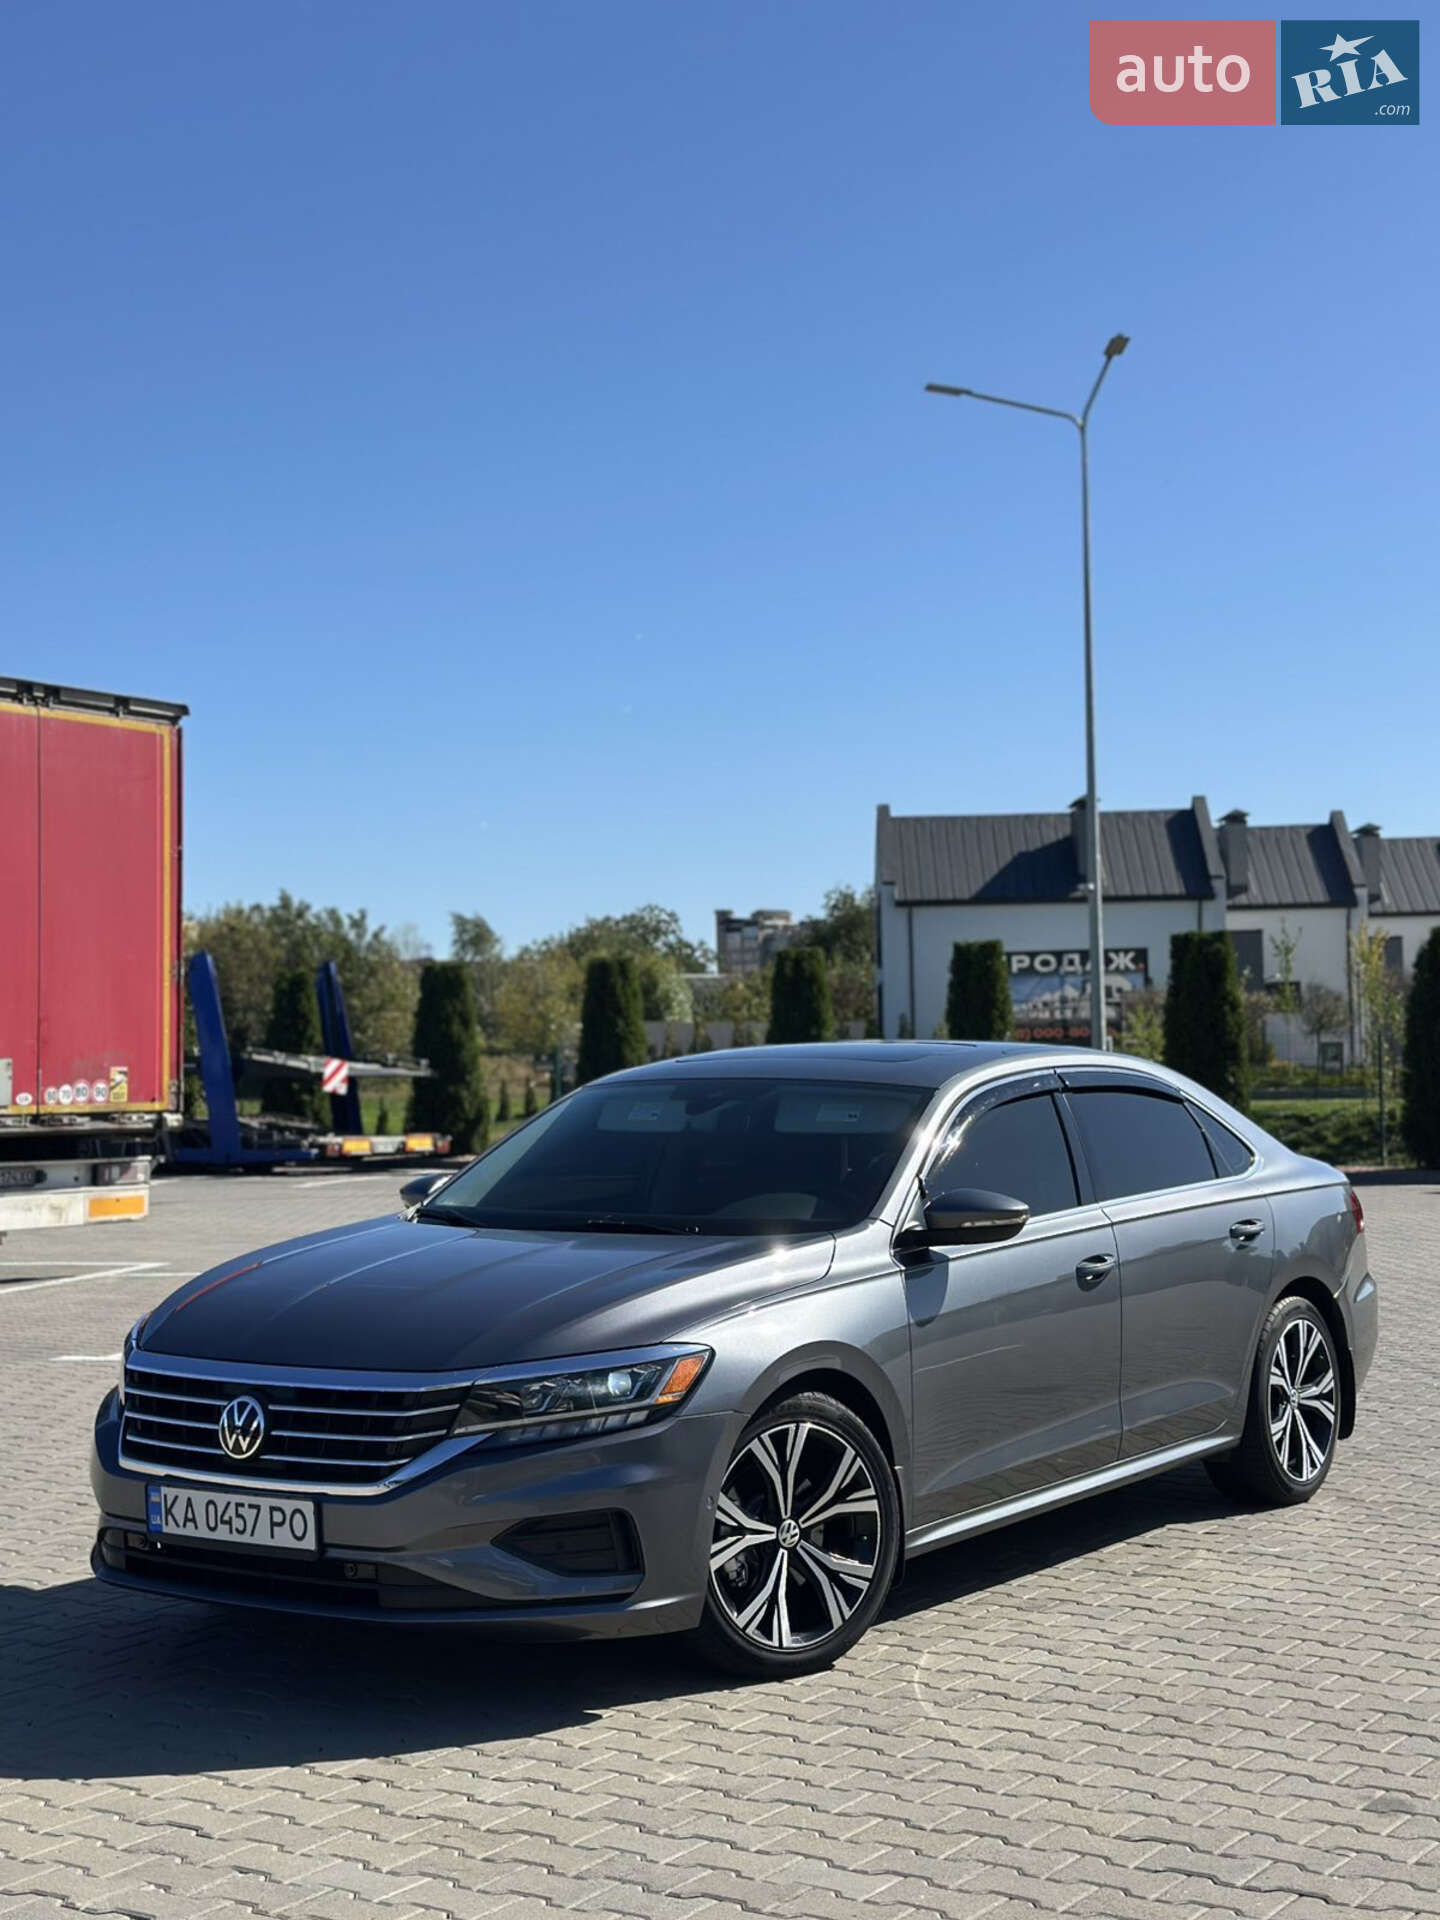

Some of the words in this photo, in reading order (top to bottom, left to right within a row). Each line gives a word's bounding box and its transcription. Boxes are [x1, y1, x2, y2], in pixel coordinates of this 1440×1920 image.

[163, 1493, 198, 1530] KA
[205, 1499, 262, 1537] 0457
[269, 1505, 308, 1542] PO
